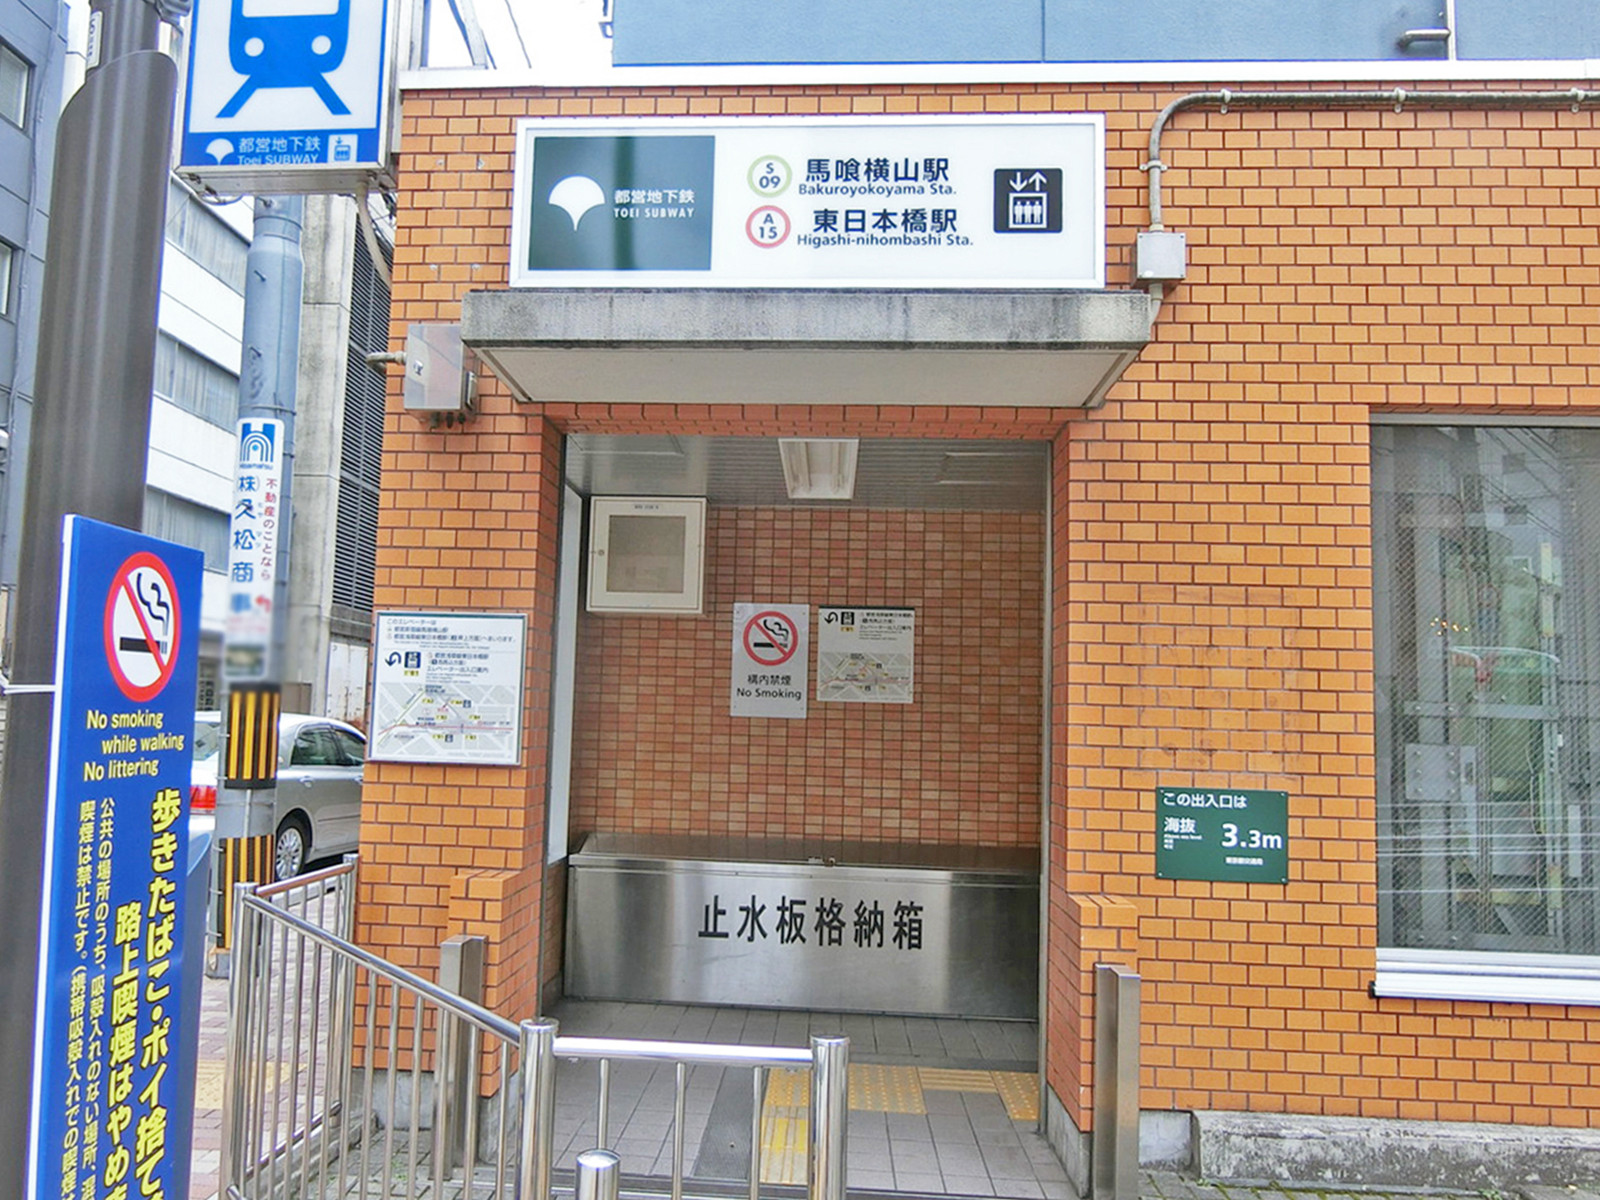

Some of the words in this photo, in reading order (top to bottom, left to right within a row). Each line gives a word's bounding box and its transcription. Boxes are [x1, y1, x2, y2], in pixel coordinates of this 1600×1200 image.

[239, 136, 321, 153] 都営地下鉄
[237, 155, 262, 165] Toei
[265, 154, 319, 165] SUBWAY
[765, 163, 775, 174] S
[806, 158, 949, 182] 馬喰横山駅
[759, 176, 780, 189] 09
[614, 189, 695, 204] 都営地下鉄
[799, 184, 923, 199] Bakuroyokoyama
[930, 184, 957, 196] Sta.
[614, 207, 640, 218] TOEI
[645, 207, 695, 218] SUBWAY
[763, 213, 774, 225] A
[813, 209, 957, 233] 東日本橋駅
[758, 226, 778, 239] 15
[797, 234, 941, 249] Higashi-nihombashi
[946, 235, 973, 247] Sta.
[260, 478, 278, 581] 不動産のことなら
[747, 674, 792, 687] 構内禁煙
[737, 687, 752, 697] No
[755, 687, 802, 700] Smoking
[86, 709, 108, 729] No
[111, 709, 164, 729] smoking
[102, 735, 137, 755] while
[140, 732, 184, 752] walking
[83, 762, 104, 782] No
[108, 757, 159, 779] littering
[1163, 793, 1247, 808] この出入口は
[1164, 817, 1196, 833] 海抜
[1221, 823, 1282, 849] 3.3m
[698, 895, 924, 950] 止水板格納箱
